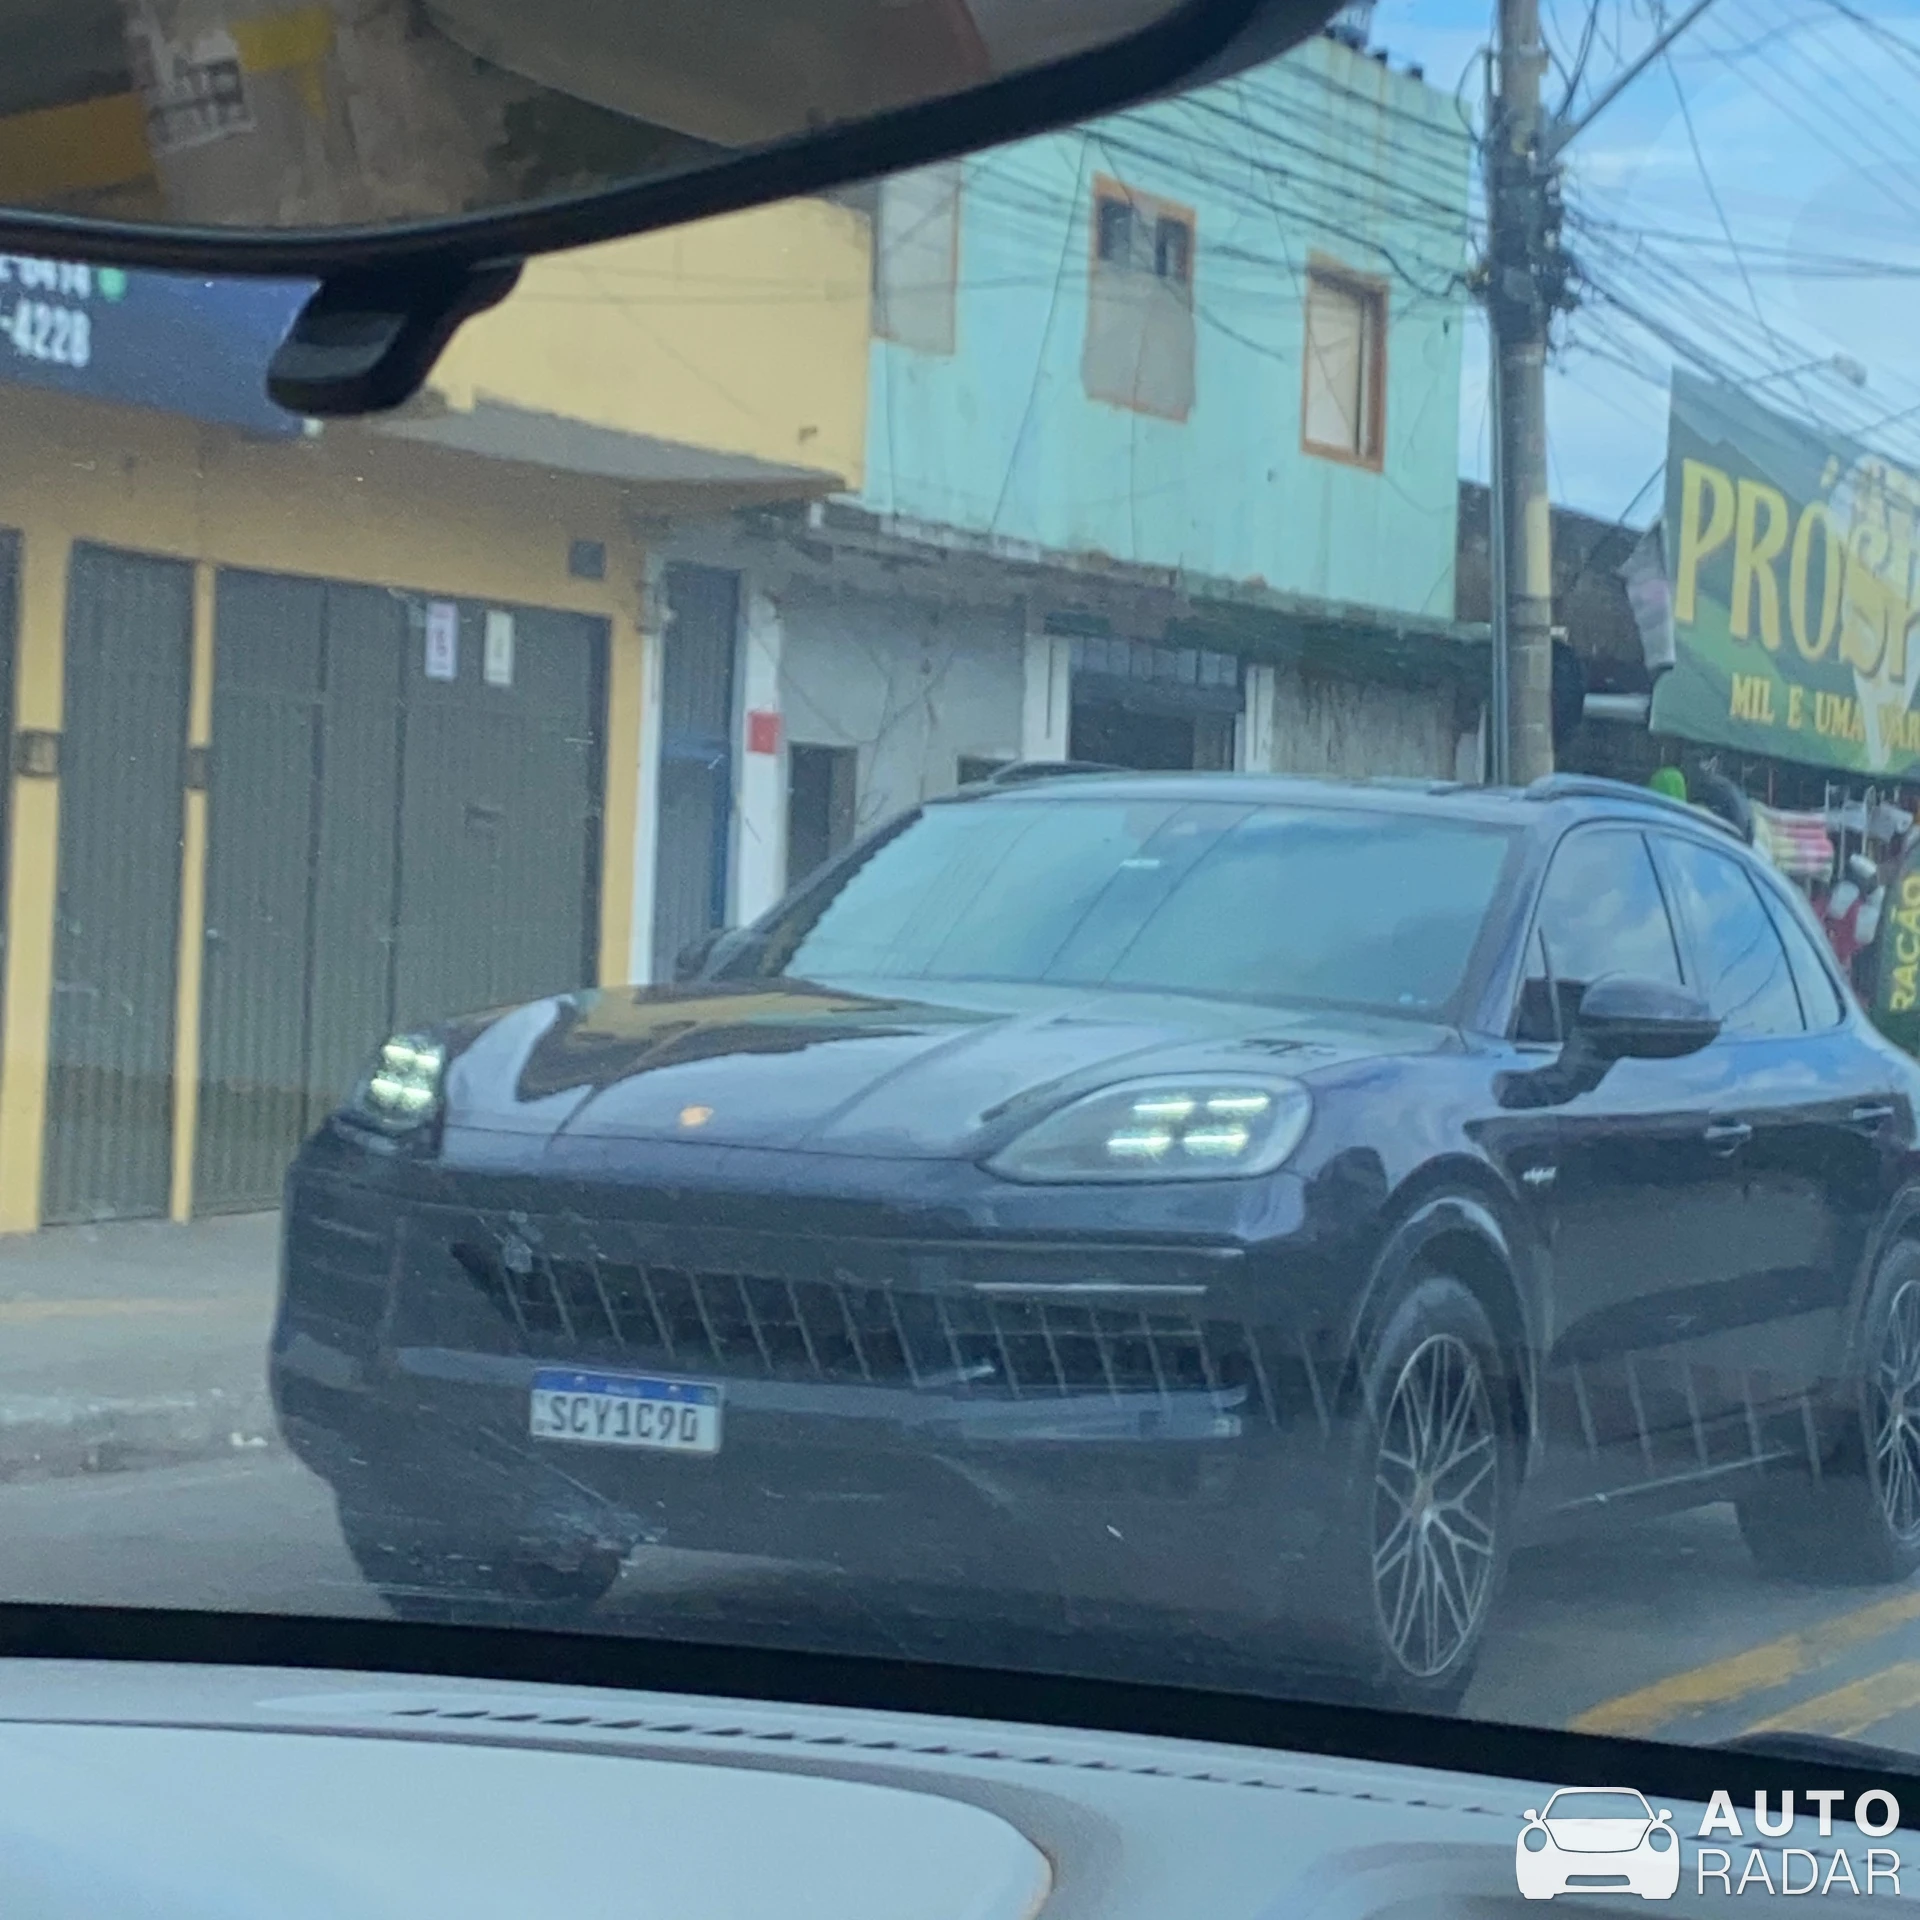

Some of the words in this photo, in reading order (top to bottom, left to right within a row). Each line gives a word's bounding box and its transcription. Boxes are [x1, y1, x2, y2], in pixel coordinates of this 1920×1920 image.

[1730, 672, 1775, 726] MIL
[1787, 685, 1804, 731] E
[1815, 691, 1866, 742] UMA
[550, 1396, 698, 1442] SCY1C90
